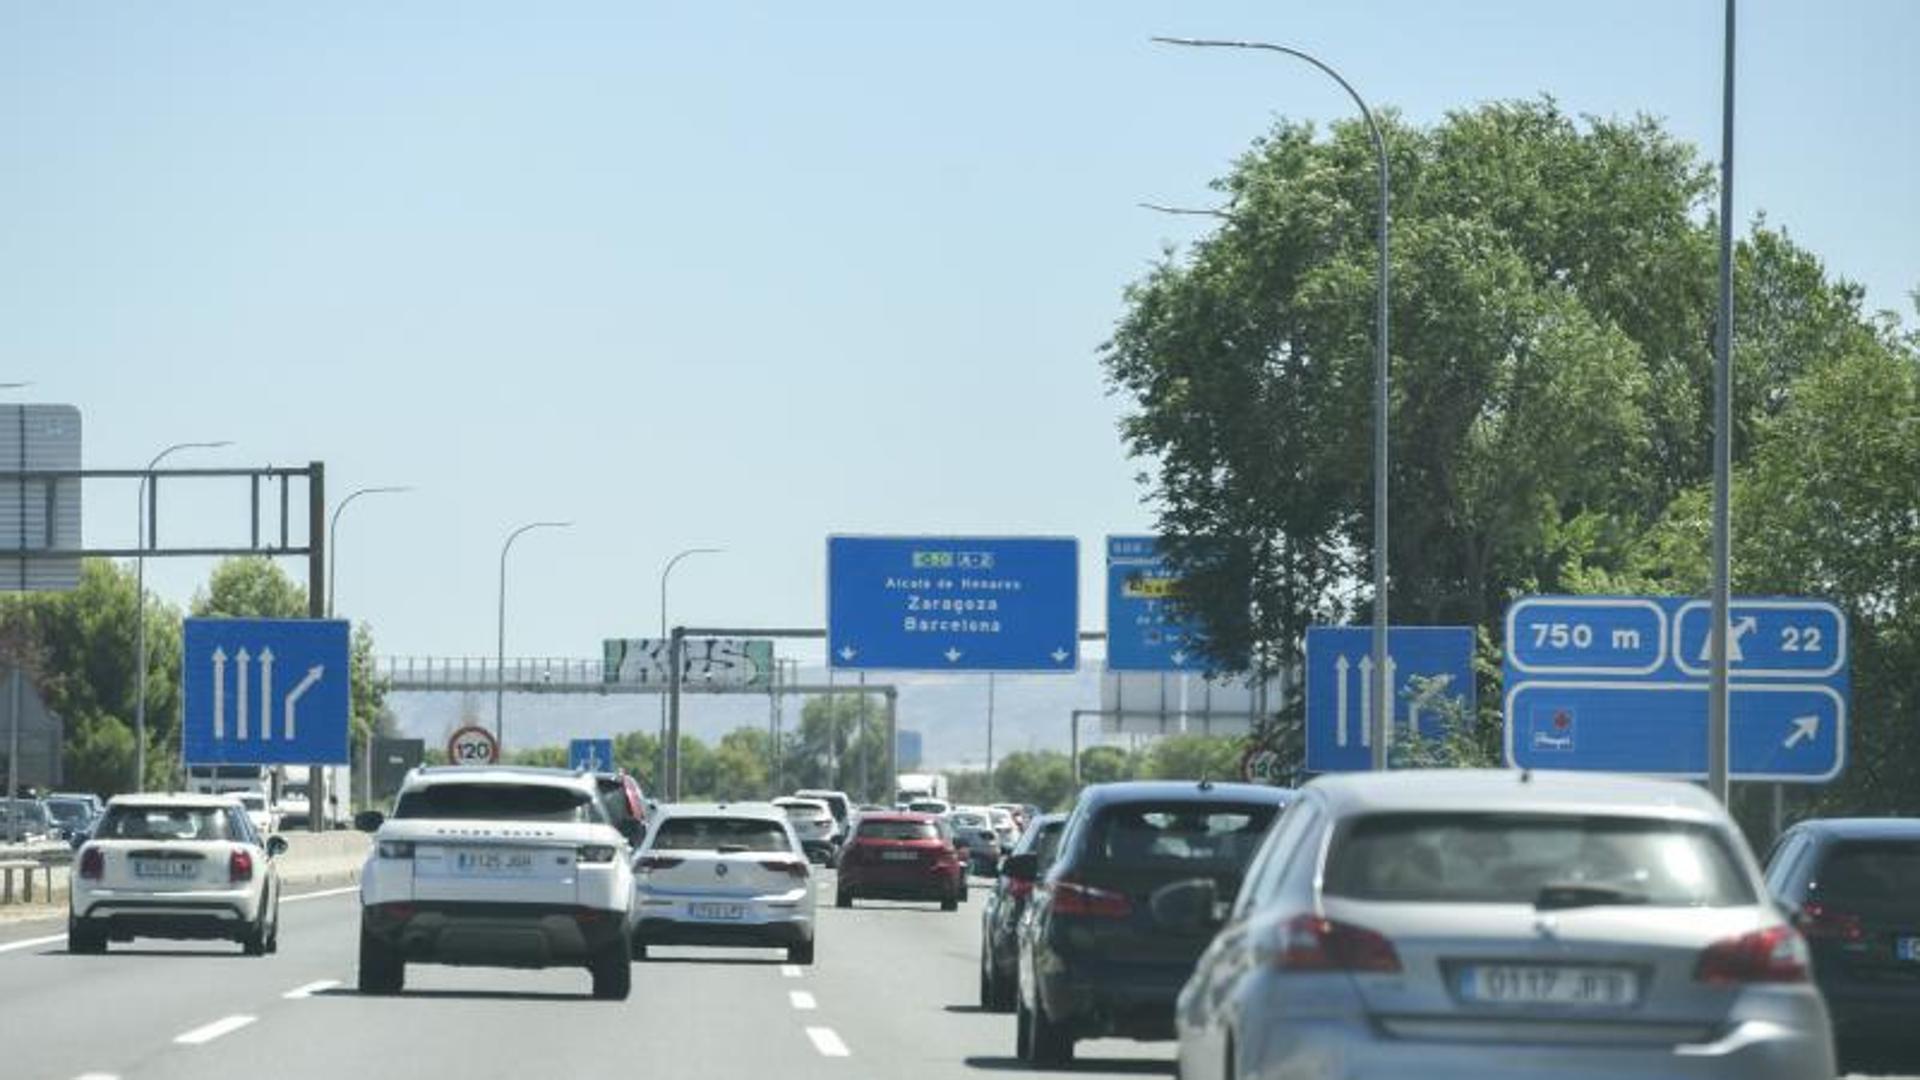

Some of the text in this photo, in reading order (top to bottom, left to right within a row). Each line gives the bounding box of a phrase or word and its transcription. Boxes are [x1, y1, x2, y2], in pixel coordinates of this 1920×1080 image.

[937, 577, 954, 590] de
[908, 594, 998, 614] Zaragoza
[903, 616, 1001, 632] Barcelona
[1529, 623, 1640, 649] 750 m
[1780, 626, 1822, 652] 22
[457, 742, 490, 760] 120
